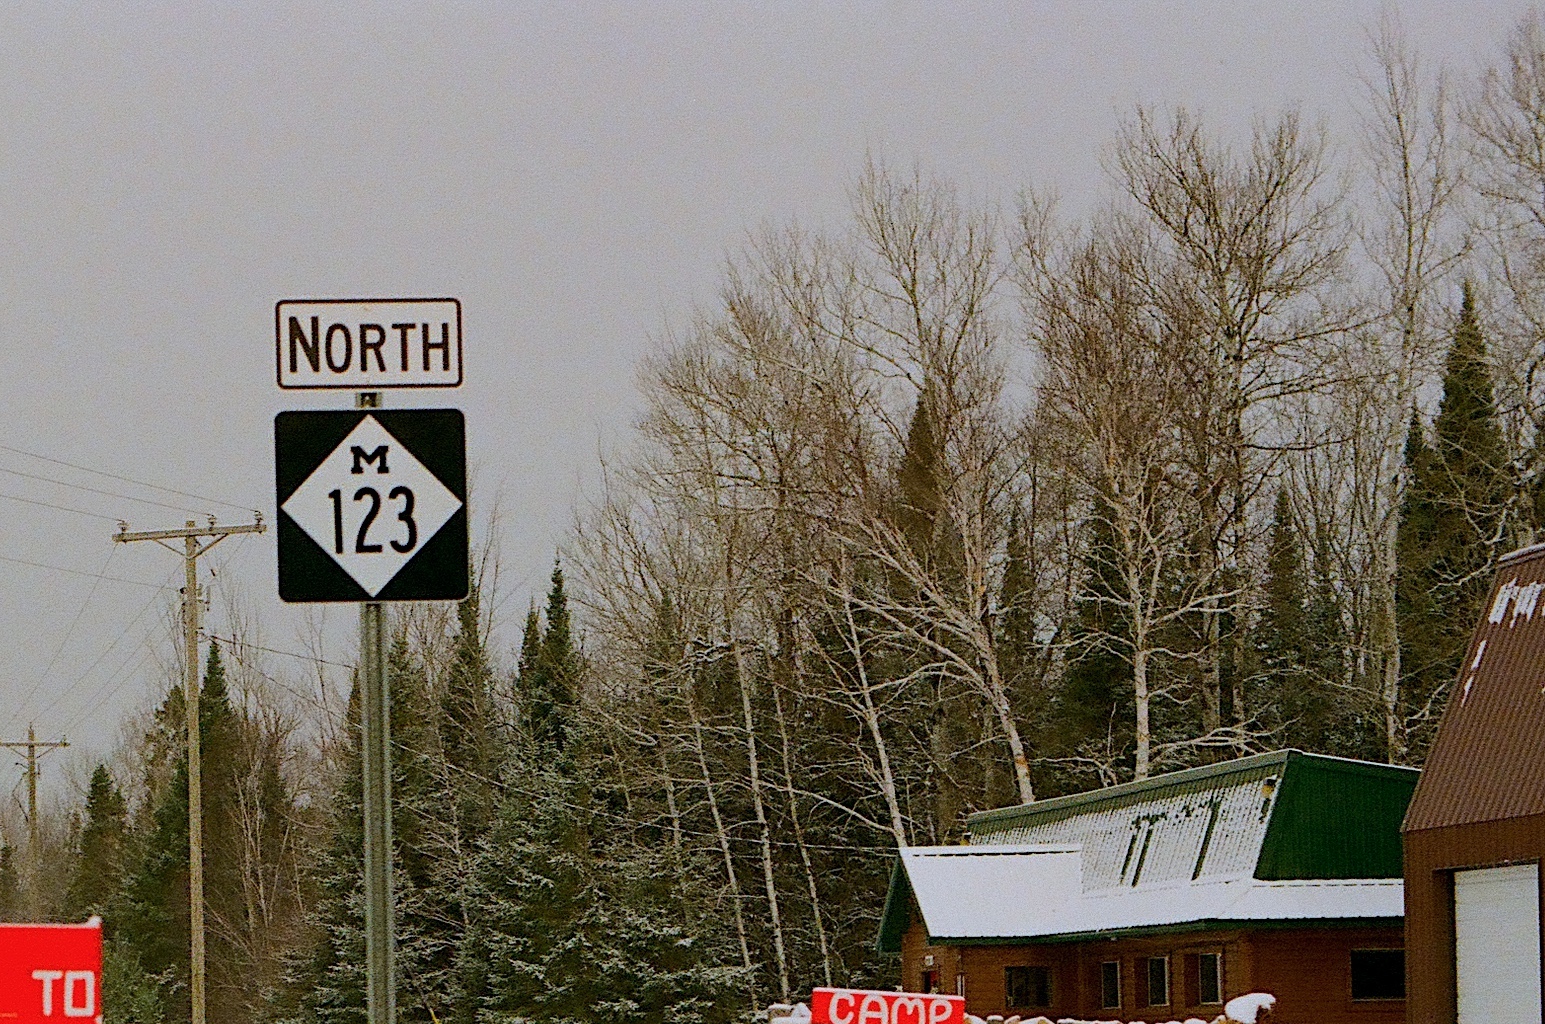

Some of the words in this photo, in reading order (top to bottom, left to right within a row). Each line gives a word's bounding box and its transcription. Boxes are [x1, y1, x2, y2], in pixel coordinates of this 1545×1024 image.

[288, 315, 450, 374] NORTH
[350, 445, 390, 475] M
[328, 486, 418, 554] 123
[31, 969, 96, 1018] TO
